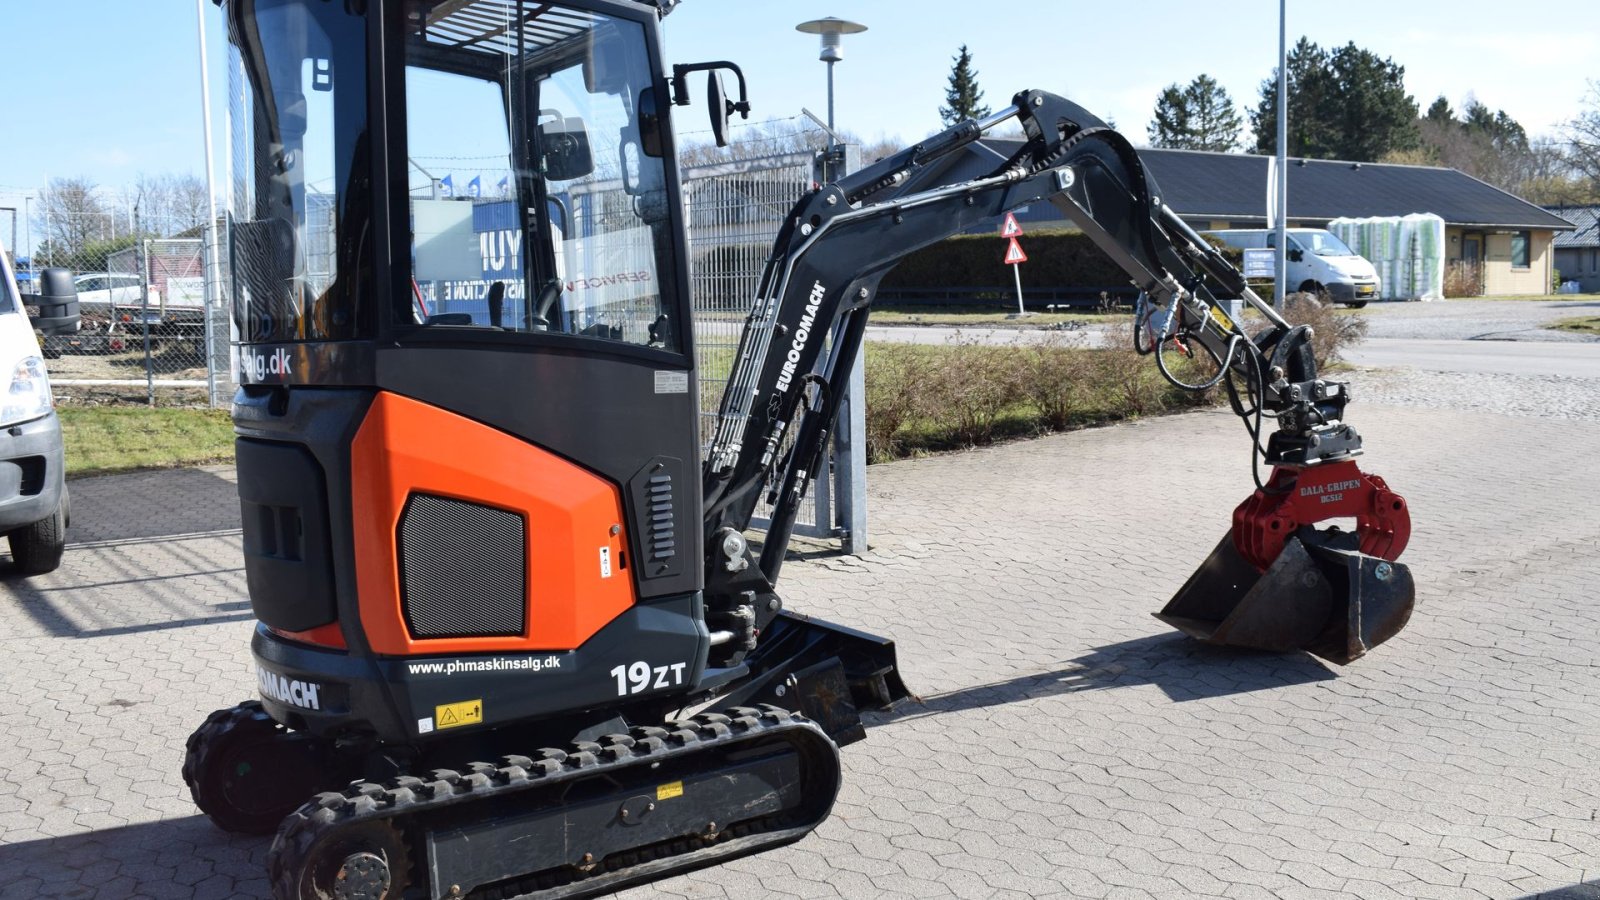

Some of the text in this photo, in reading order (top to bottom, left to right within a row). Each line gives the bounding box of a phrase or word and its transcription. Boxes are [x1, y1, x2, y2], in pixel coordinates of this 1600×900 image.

[776, 280, 826, 392] EUROCOMACH
[1300, 480, 1361, 496] DALA-GRIPEN
[409, 656, 561, 675] www.phmaskinsalg.dk
[256, 665, 319, 710] OMACH
